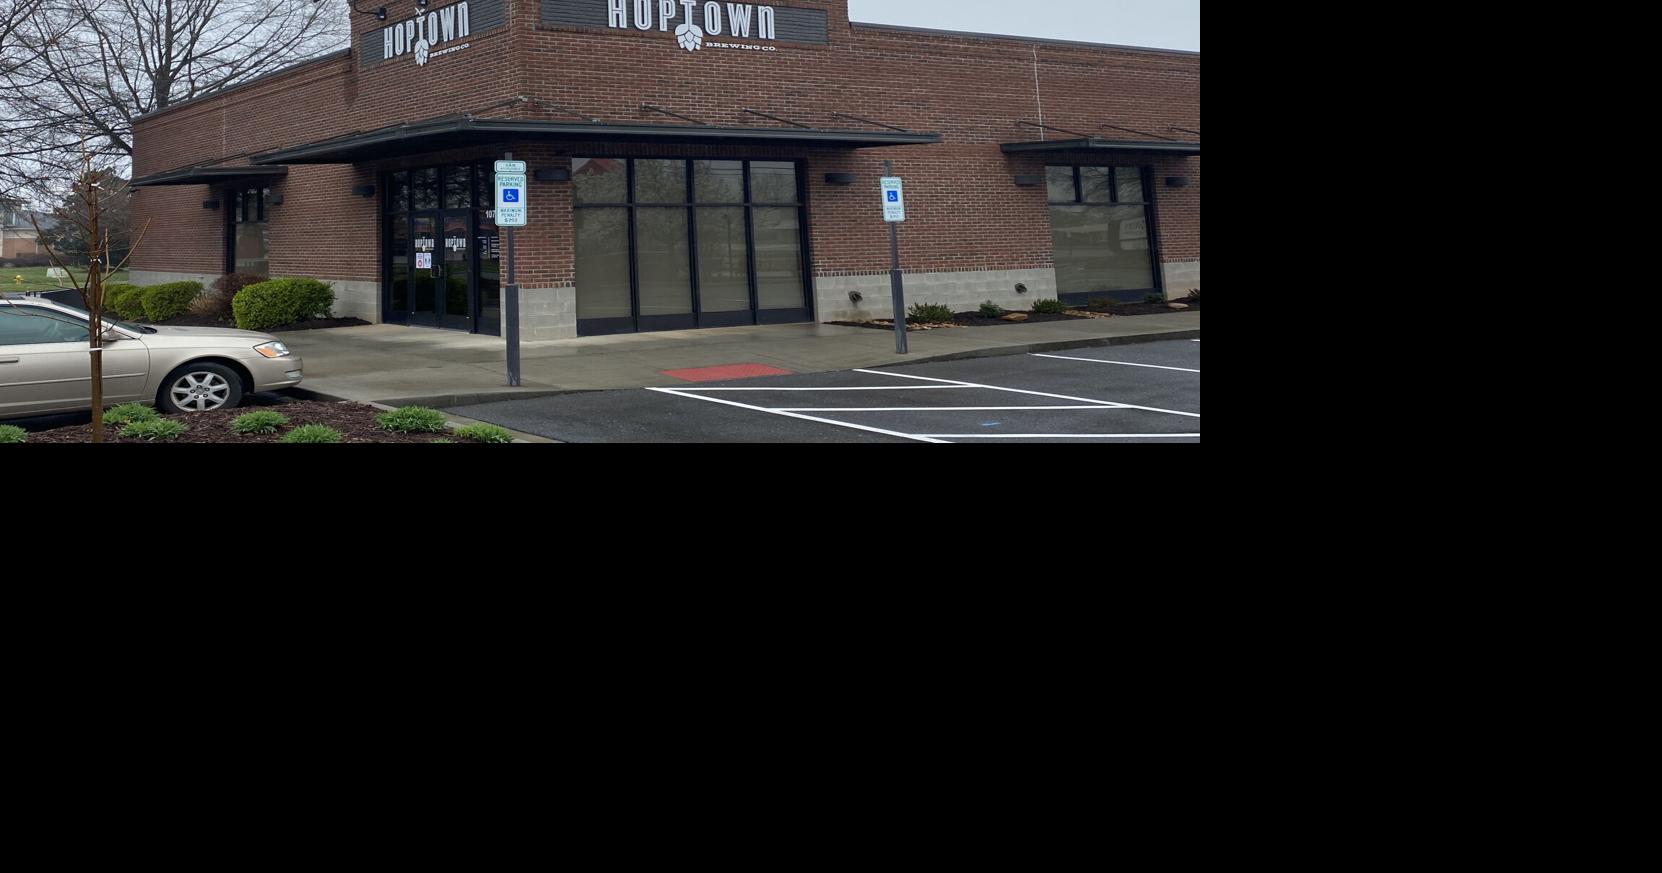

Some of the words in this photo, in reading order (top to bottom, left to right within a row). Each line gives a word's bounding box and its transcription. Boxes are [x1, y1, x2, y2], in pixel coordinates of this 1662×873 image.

[383, 1, 470, 60] HOPTOWN
[607, 0, 775, 40] HOPTOWN
[705, 41, 760, 50] BREWING
